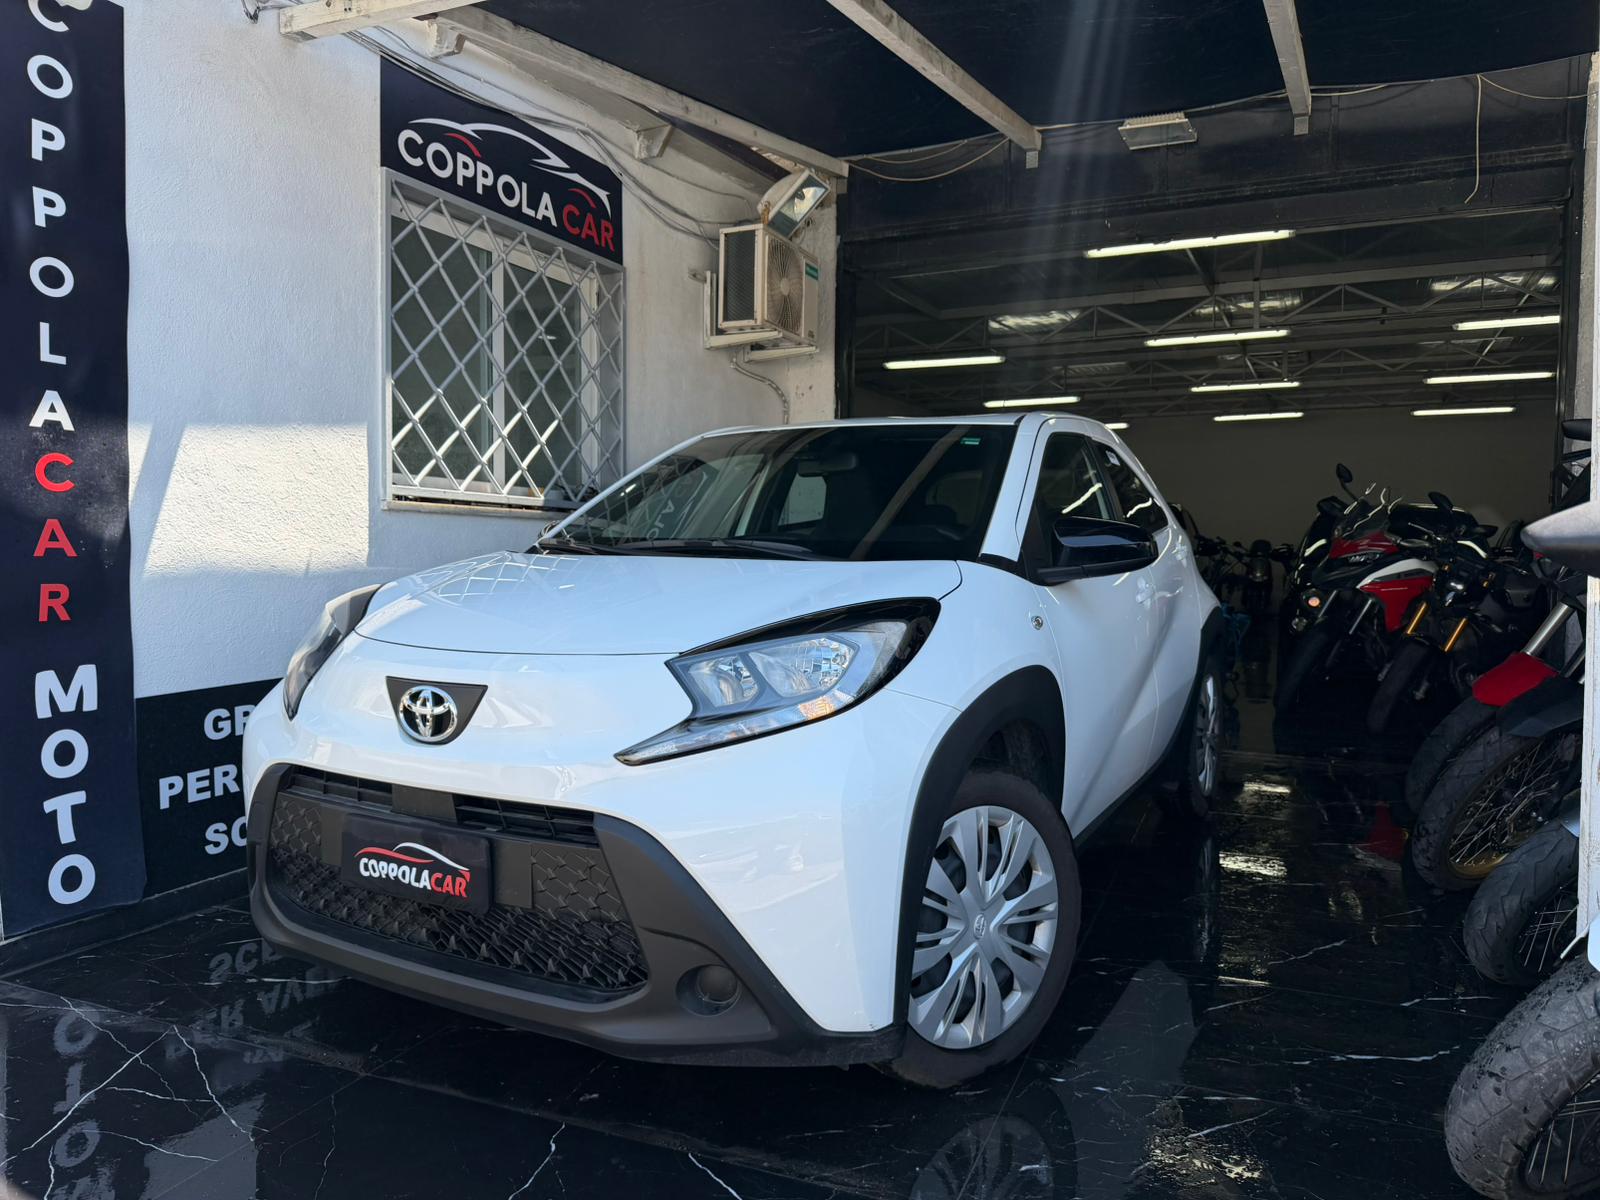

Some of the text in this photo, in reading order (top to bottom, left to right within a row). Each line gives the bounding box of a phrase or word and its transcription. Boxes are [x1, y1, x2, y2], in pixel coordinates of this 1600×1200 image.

[204, 704, 256, 740] GR
[35, 664, 98, 904] MOTO
[159, 764, 240, 810] PER
